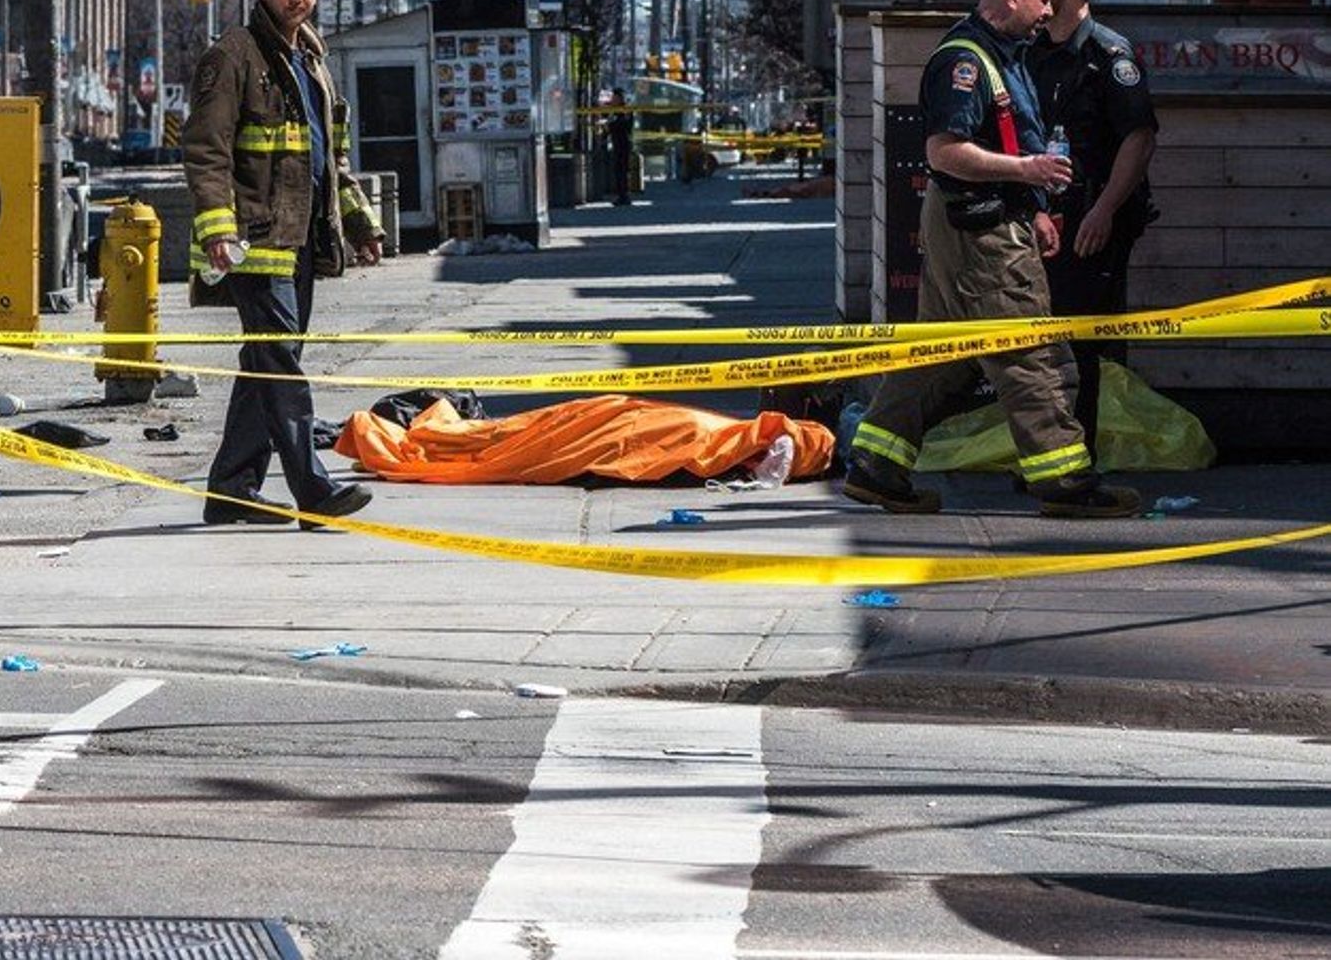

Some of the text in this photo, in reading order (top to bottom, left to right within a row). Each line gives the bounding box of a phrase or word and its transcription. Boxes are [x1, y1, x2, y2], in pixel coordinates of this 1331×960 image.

[1232, 41, 1300, 75] BBQ
[909, 344, 954, 357] POLICE
[996, 337, 1011, 348] DO
[1015, 334, 1037, 346] NOT
[1039, 330, 1075, 344] CROSS
[728, 358, 772, 372] POLICE
[813, 354, 828, 365] DO
[831, 353, 852, 364] NOT
[856, 350, 891, 363] CROSS
